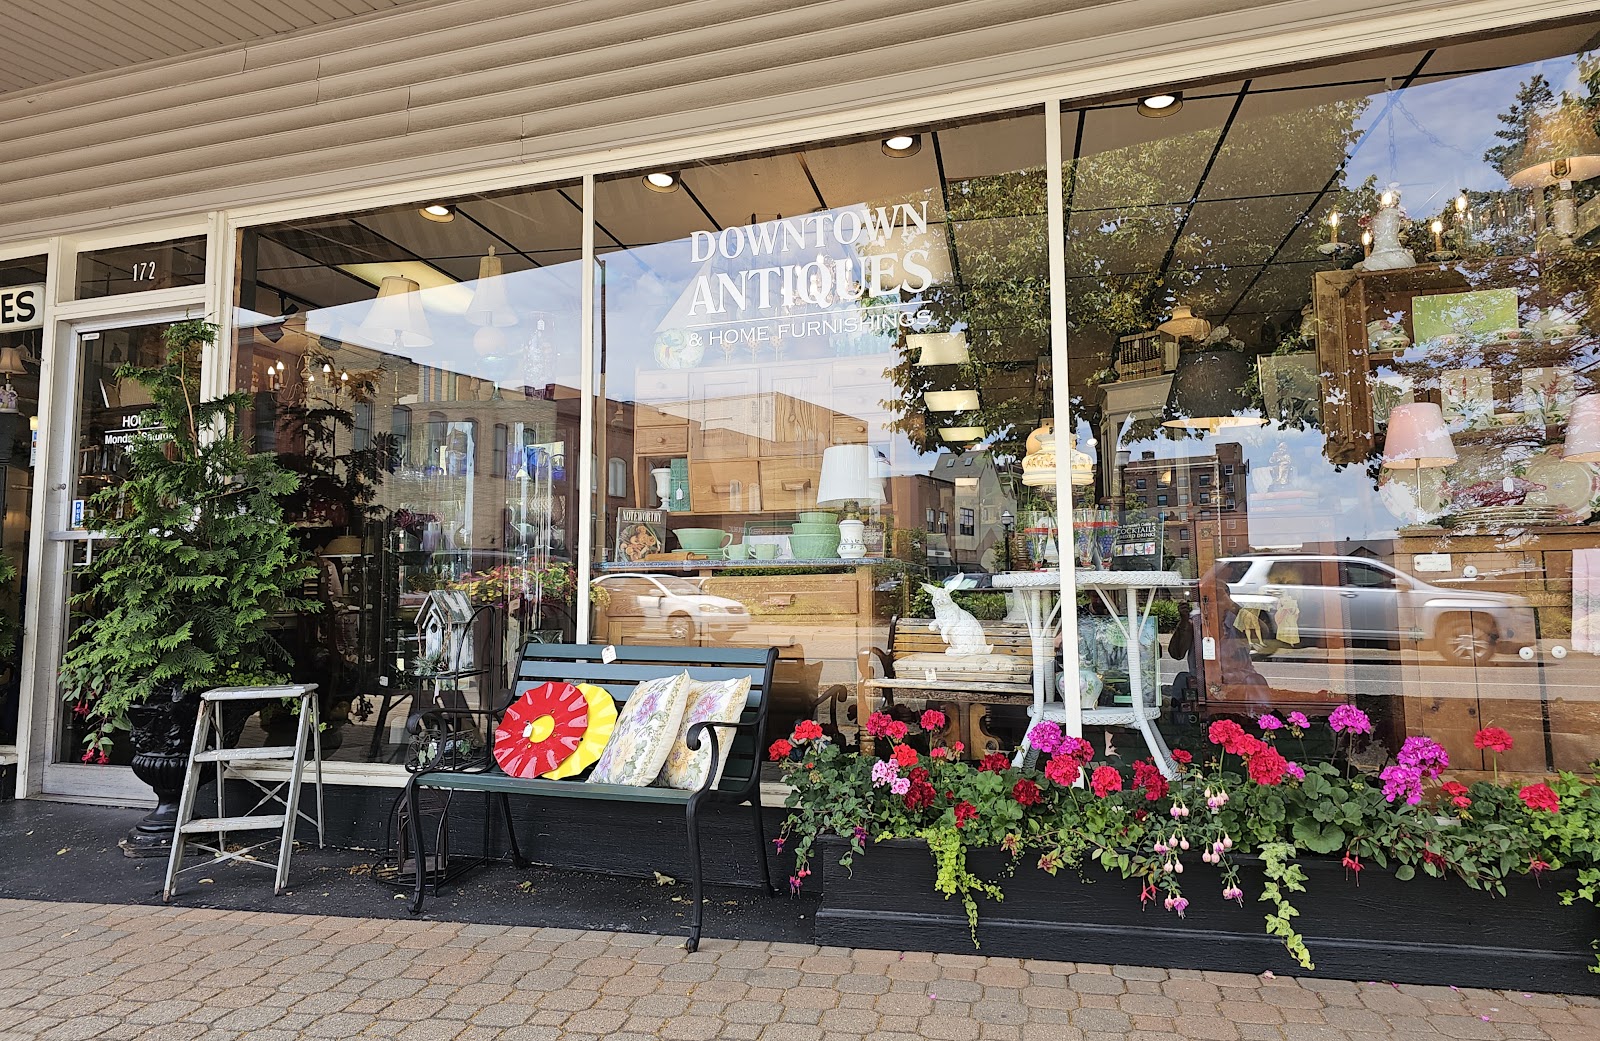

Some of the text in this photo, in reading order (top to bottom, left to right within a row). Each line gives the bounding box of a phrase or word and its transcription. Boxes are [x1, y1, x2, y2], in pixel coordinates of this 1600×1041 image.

[690, 201, 928, 262] DOWNTOWN
[133, 261, 155, 281] 172
[688, 250, 933, 315] ANTIQUES
[1, 291, 35, 323] ES
[689, 310, 932, 347] & HOME FURNISHINGS
